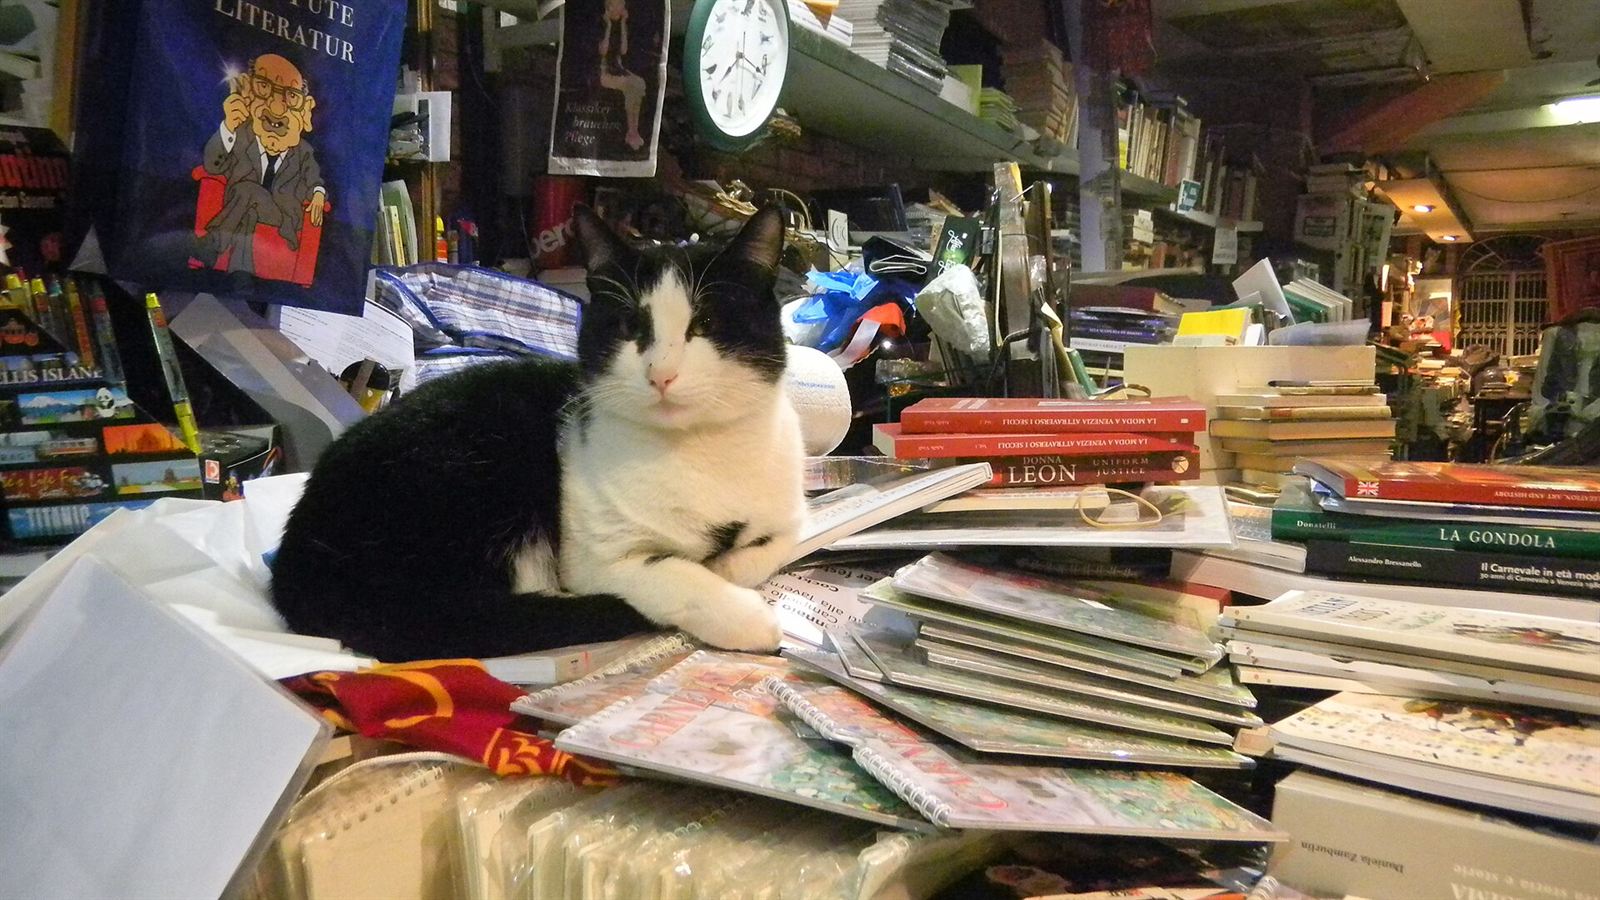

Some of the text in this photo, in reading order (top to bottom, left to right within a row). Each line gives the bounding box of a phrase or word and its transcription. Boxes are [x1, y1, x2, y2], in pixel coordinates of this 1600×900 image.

[215, 0, 355, 63] LITERATUR
[1122, 417, 1146, 425] MODA
[1147, 417, 1157, 425] LA
[1029, 440, 1075, 448] ATTRAVERSO
[1114, 438, 1137, 446] MODA
[1023, 456, 1061, 465] DONNA
[1093, 458, 1149, 466] UNIFORM
[1008, 464, 1076, 484] LEON
[1096, 468, 1145, 477] JUSTICE
[1297, 520, 1336, 529] Donatelli
[1440, 528, 1556, 549] LA GONDOLA
[1348, 556, 1422, 568] Alessandro Bressanello
[1481, 562, 1600, 581] Il Carnevale in età mod
[1515, 575, 1549, 584] Carnevale
[1556, 579, 1584, 587] Venezia
[768, 580, 845, 616] alla Tavern
[1301, 841, 1404, 874] Daniela Zamburlin
[1453, 864, 1498, 882] storie
[1505, 875, 1514, 885] e
